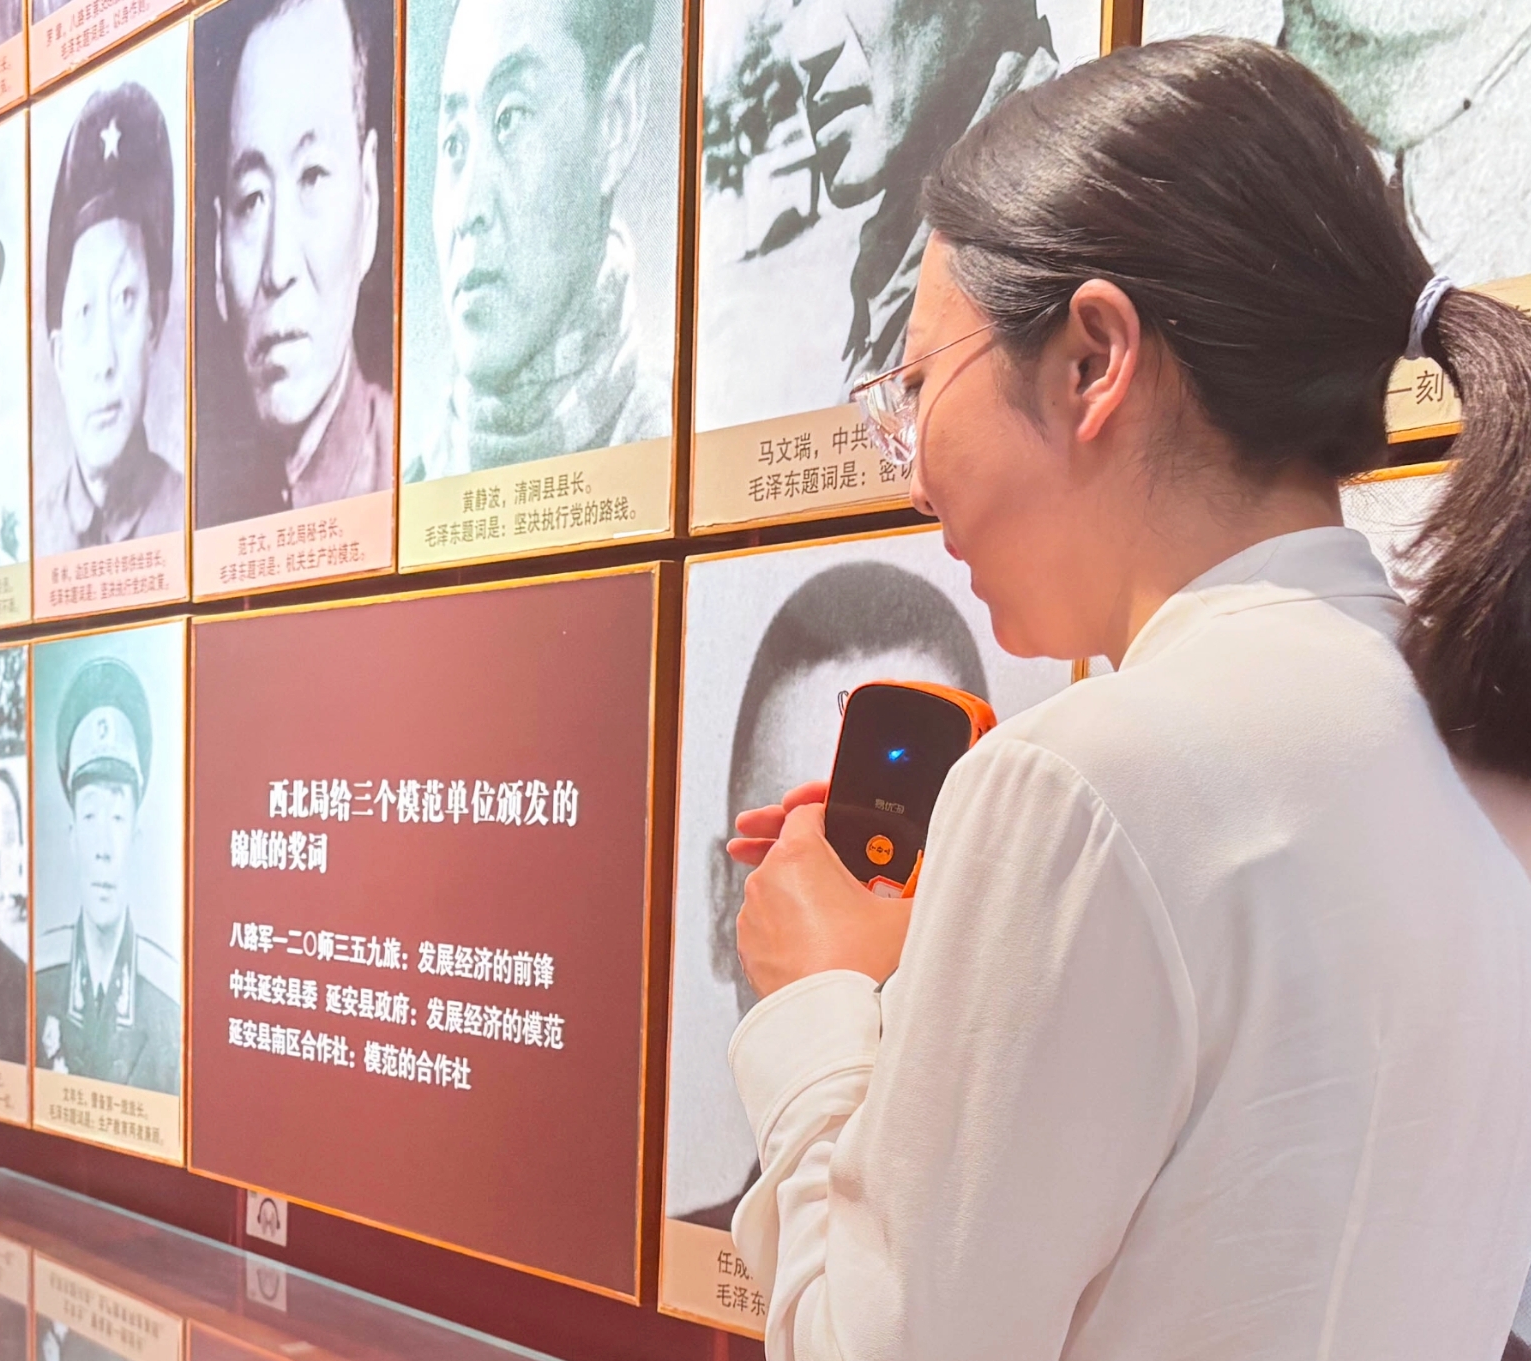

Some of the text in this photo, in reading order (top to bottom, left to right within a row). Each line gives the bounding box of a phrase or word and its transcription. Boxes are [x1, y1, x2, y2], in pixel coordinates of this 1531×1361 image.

[758, 424, 879, 463] 马文瑞，中共
[462, 472, 593, 513] 黄静波，清涧县县长。
[424, 497, 637, 548] 毛泽东题词是：坚决执行党的路线。
[268, 778, 579, 827] 西北局给三个模范单位颁发的
[230, 829, 328, 874] 锦旗的奖词
[229, 969, 566, 1050] 中共延安县委 延安县政府：发展经济的模范
[228, 1017, 472, 1090] 延安县南区合作社：模范的合作社
[717, 1250, 754, 1281] 任成
[716, 1283, 767, 1317] 毛泽东
